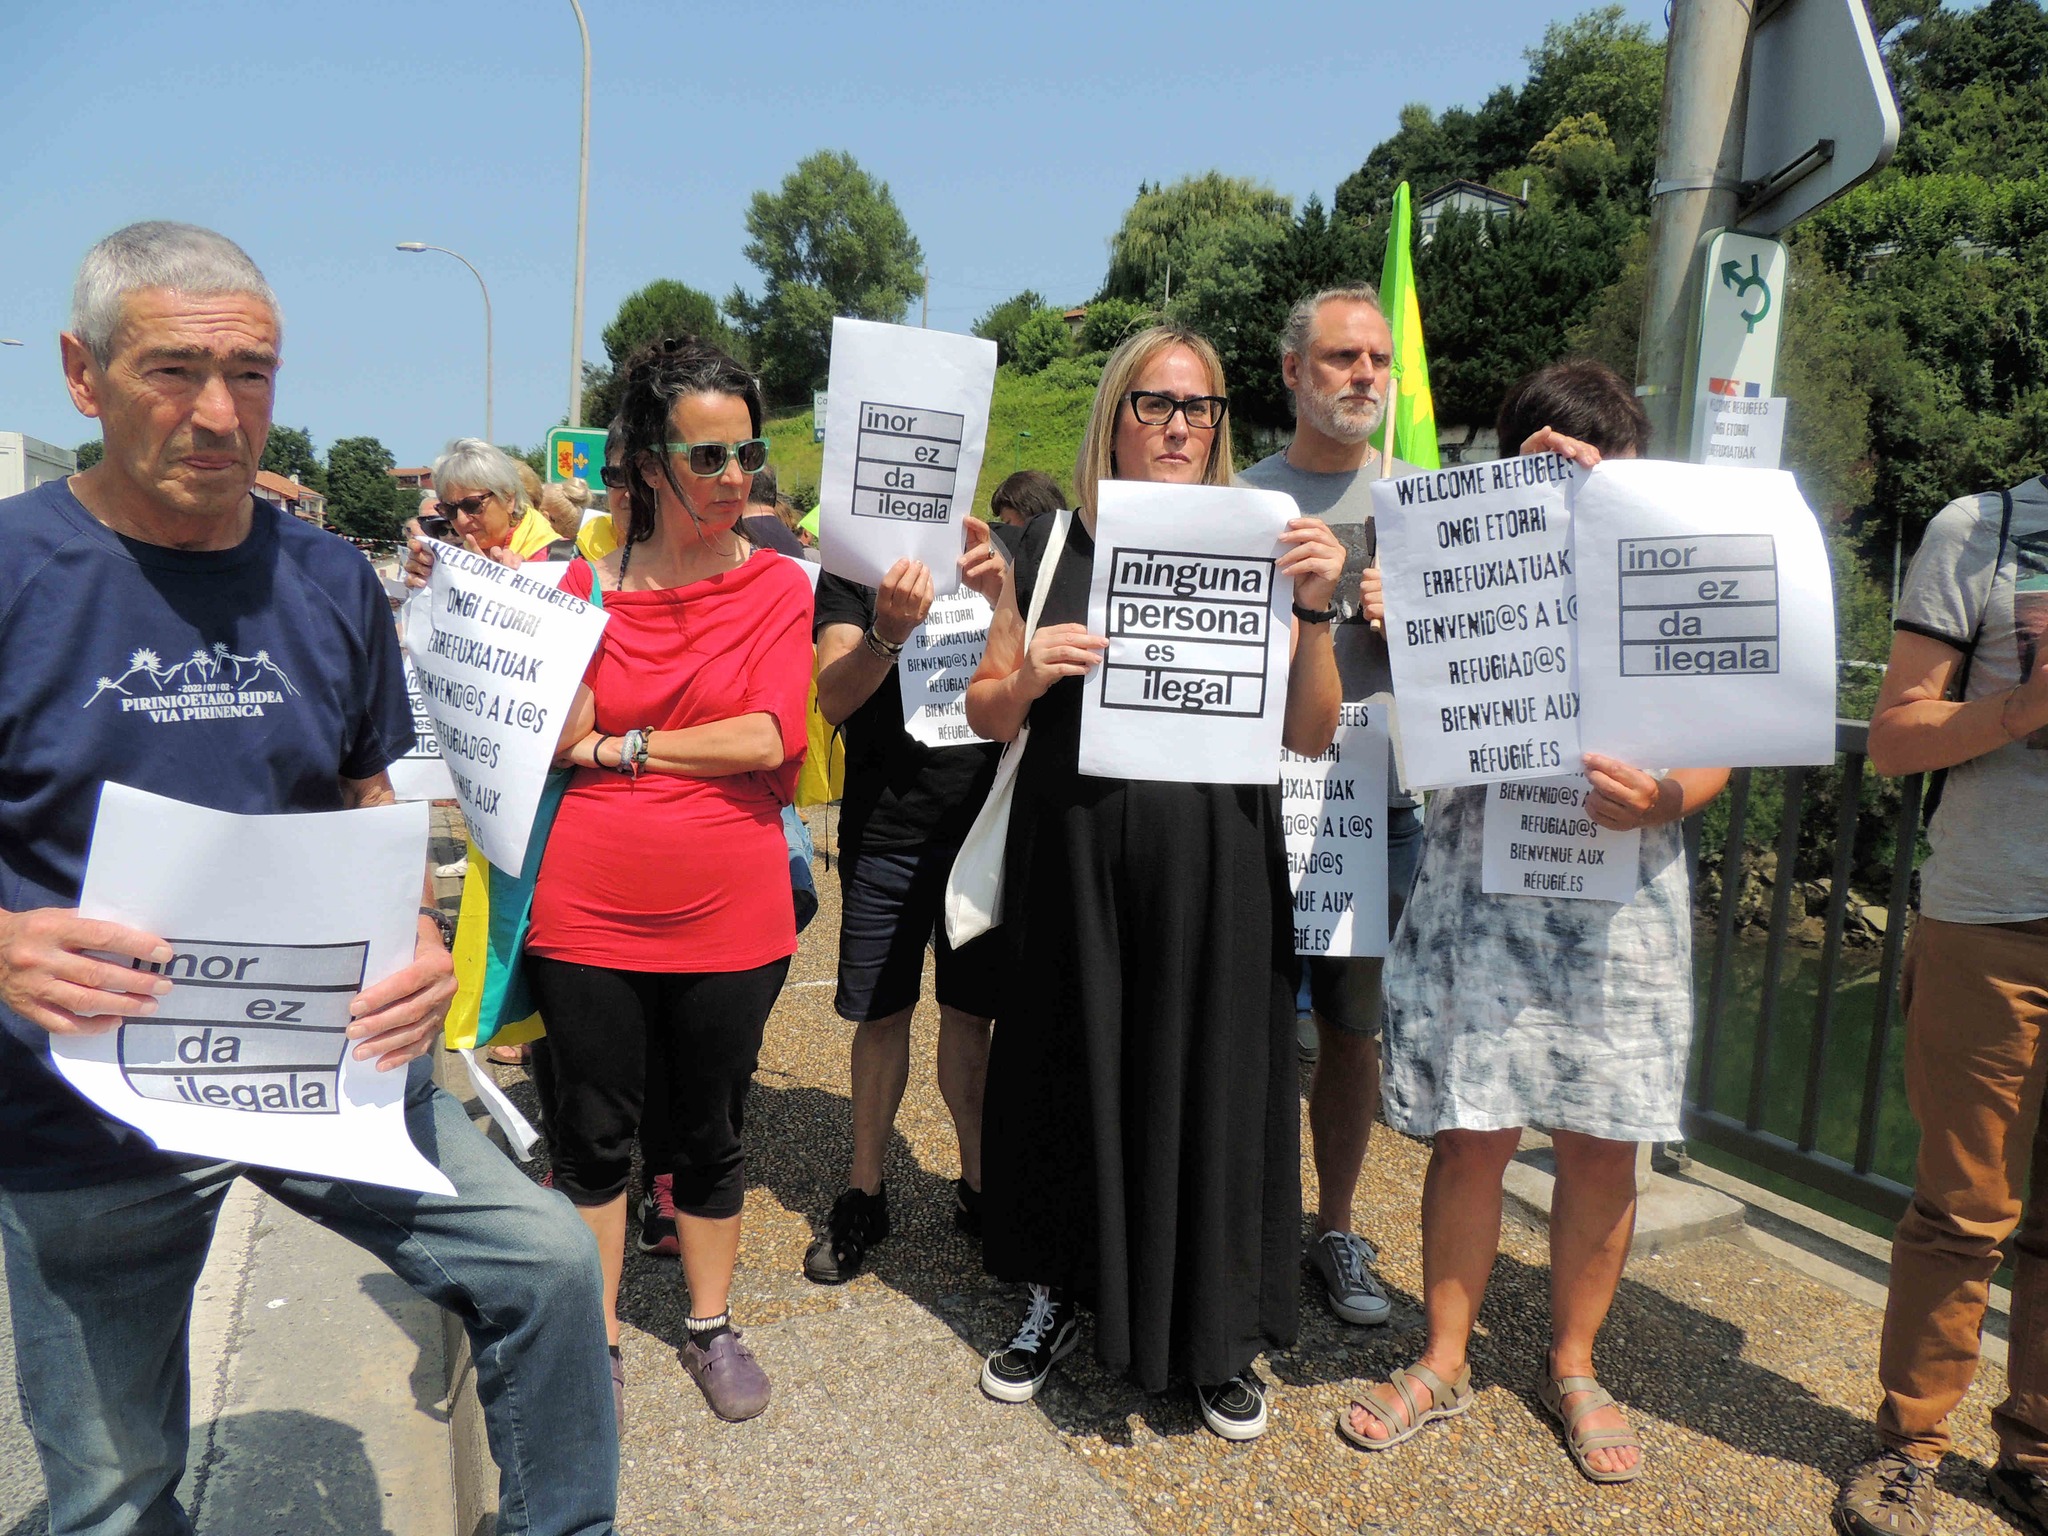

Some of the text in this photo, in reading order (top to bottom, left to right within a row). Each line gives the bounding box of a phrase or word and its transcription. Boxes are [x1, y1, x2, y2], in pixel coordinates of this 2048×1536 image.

[867, 406, 918, 432] inor
[915, 446, 940, 464] ez
[884, 467, 915, 489] da
[1396, 467, 1486, 506] WELCOME
[878, 493, 948, 520] ilegala
[1437, 505, 1547, 548] ONGI ETORRI
[1629, 544, 1697, 569] inor
[428, 540, 589, 615] WELCOME REFUGEES
[1120, 554, 1262, 598] ninguna
[1423, 549, 1572, 597] ERREFUXIATUAK
[1698, 580, 1739, 600] ez
[447, 587, 542, 637] ONGI ETORRI
[945, 608, 975, 624] ETORRI
[1118, 601, 1260, 636] persona
[1406, 604, 1528, 646] BIENVENID@S
[1535, 601, 1550, 628] A
[1659, 611, 1702, 637] da
[916, 629, 987, 649] ERREFUXIATUAK
[428, 629, 543, 683] ERREFUXIATUAK
[907, 653, 968, 672] BIENVENID@S
[970, 654, 978, 667] A
[1144, 644, 1175, 662] es
[1449, 646, 1566, 684] REFUGIAD@S
[1655, 643, 1770, 674] ilegala
[121, 691, 284, 712] PIRINIOETAKO BIDEA
[1142, 671, 1233, 709] ilegal
[149, 705, 264, 723] VIA PIRINENCA
[487, 695, 499, 722] A
[504, 699, 547, 734] L@S
[1441, 692, 1581, 733] BIENVENUE AUX
[1469, 738, 1560, 774] RÉFUGIÉ.ES
[475, 784, 501, 816] AUX
[1499, 783, 1578, 807] BIENVENID@S
[1323, 816, 1335, 837] A
[1340, 815, 1373, 839] L@S
[1521, 814, 1598, 838] REFUGIAD@S
[1510, 843, 1605, 865] BIENVENUE AUX
[1524, 871, 1584, 892] RÉFUGIÉ.ES
[1321, 890, 1354, 913] AUX
[151, 953, 259, 981] nor
[245, 998, 306, 1022] ez
[177, 1028, 241, 1065] da
[174, 1074, 328, 1112] ilegala
